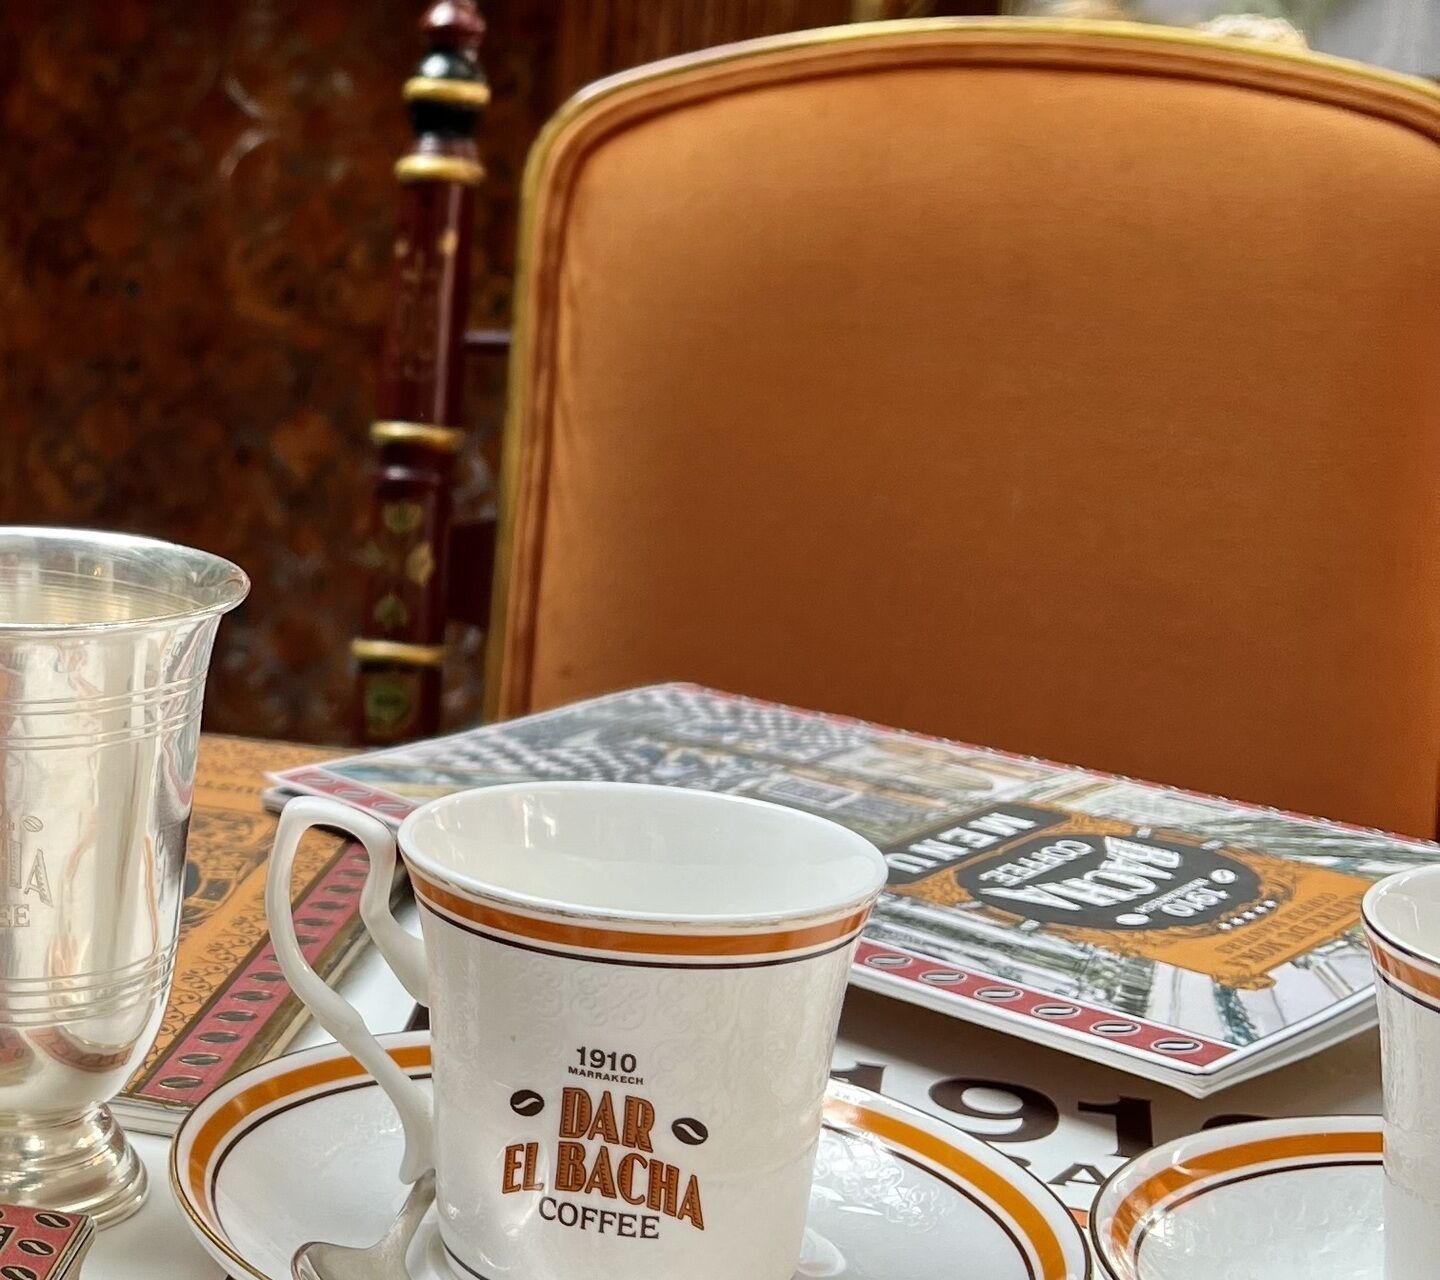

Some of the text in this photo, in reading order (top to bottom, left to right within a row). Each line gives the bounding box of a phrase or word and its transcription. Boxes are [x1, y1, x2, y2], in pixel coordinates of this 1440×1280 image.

[885, 812, 1038, 874] MENU
[979, 839, 1095, 886] COFFEE
[980, 835, 1183, 911] BACHA
[1160, 887, 1232, 918] 1910
[568, 1066, 644, 1085] MARRAKECH
[576, 1046, 637, 1073] 1910
[558, 1087, 657, 1153] DAR
[830, 1061, 1278, 1157] 191
[502, 1139, 706, 1231] EL BACHA
[538, 1195, 661, 1240] COFFEE
